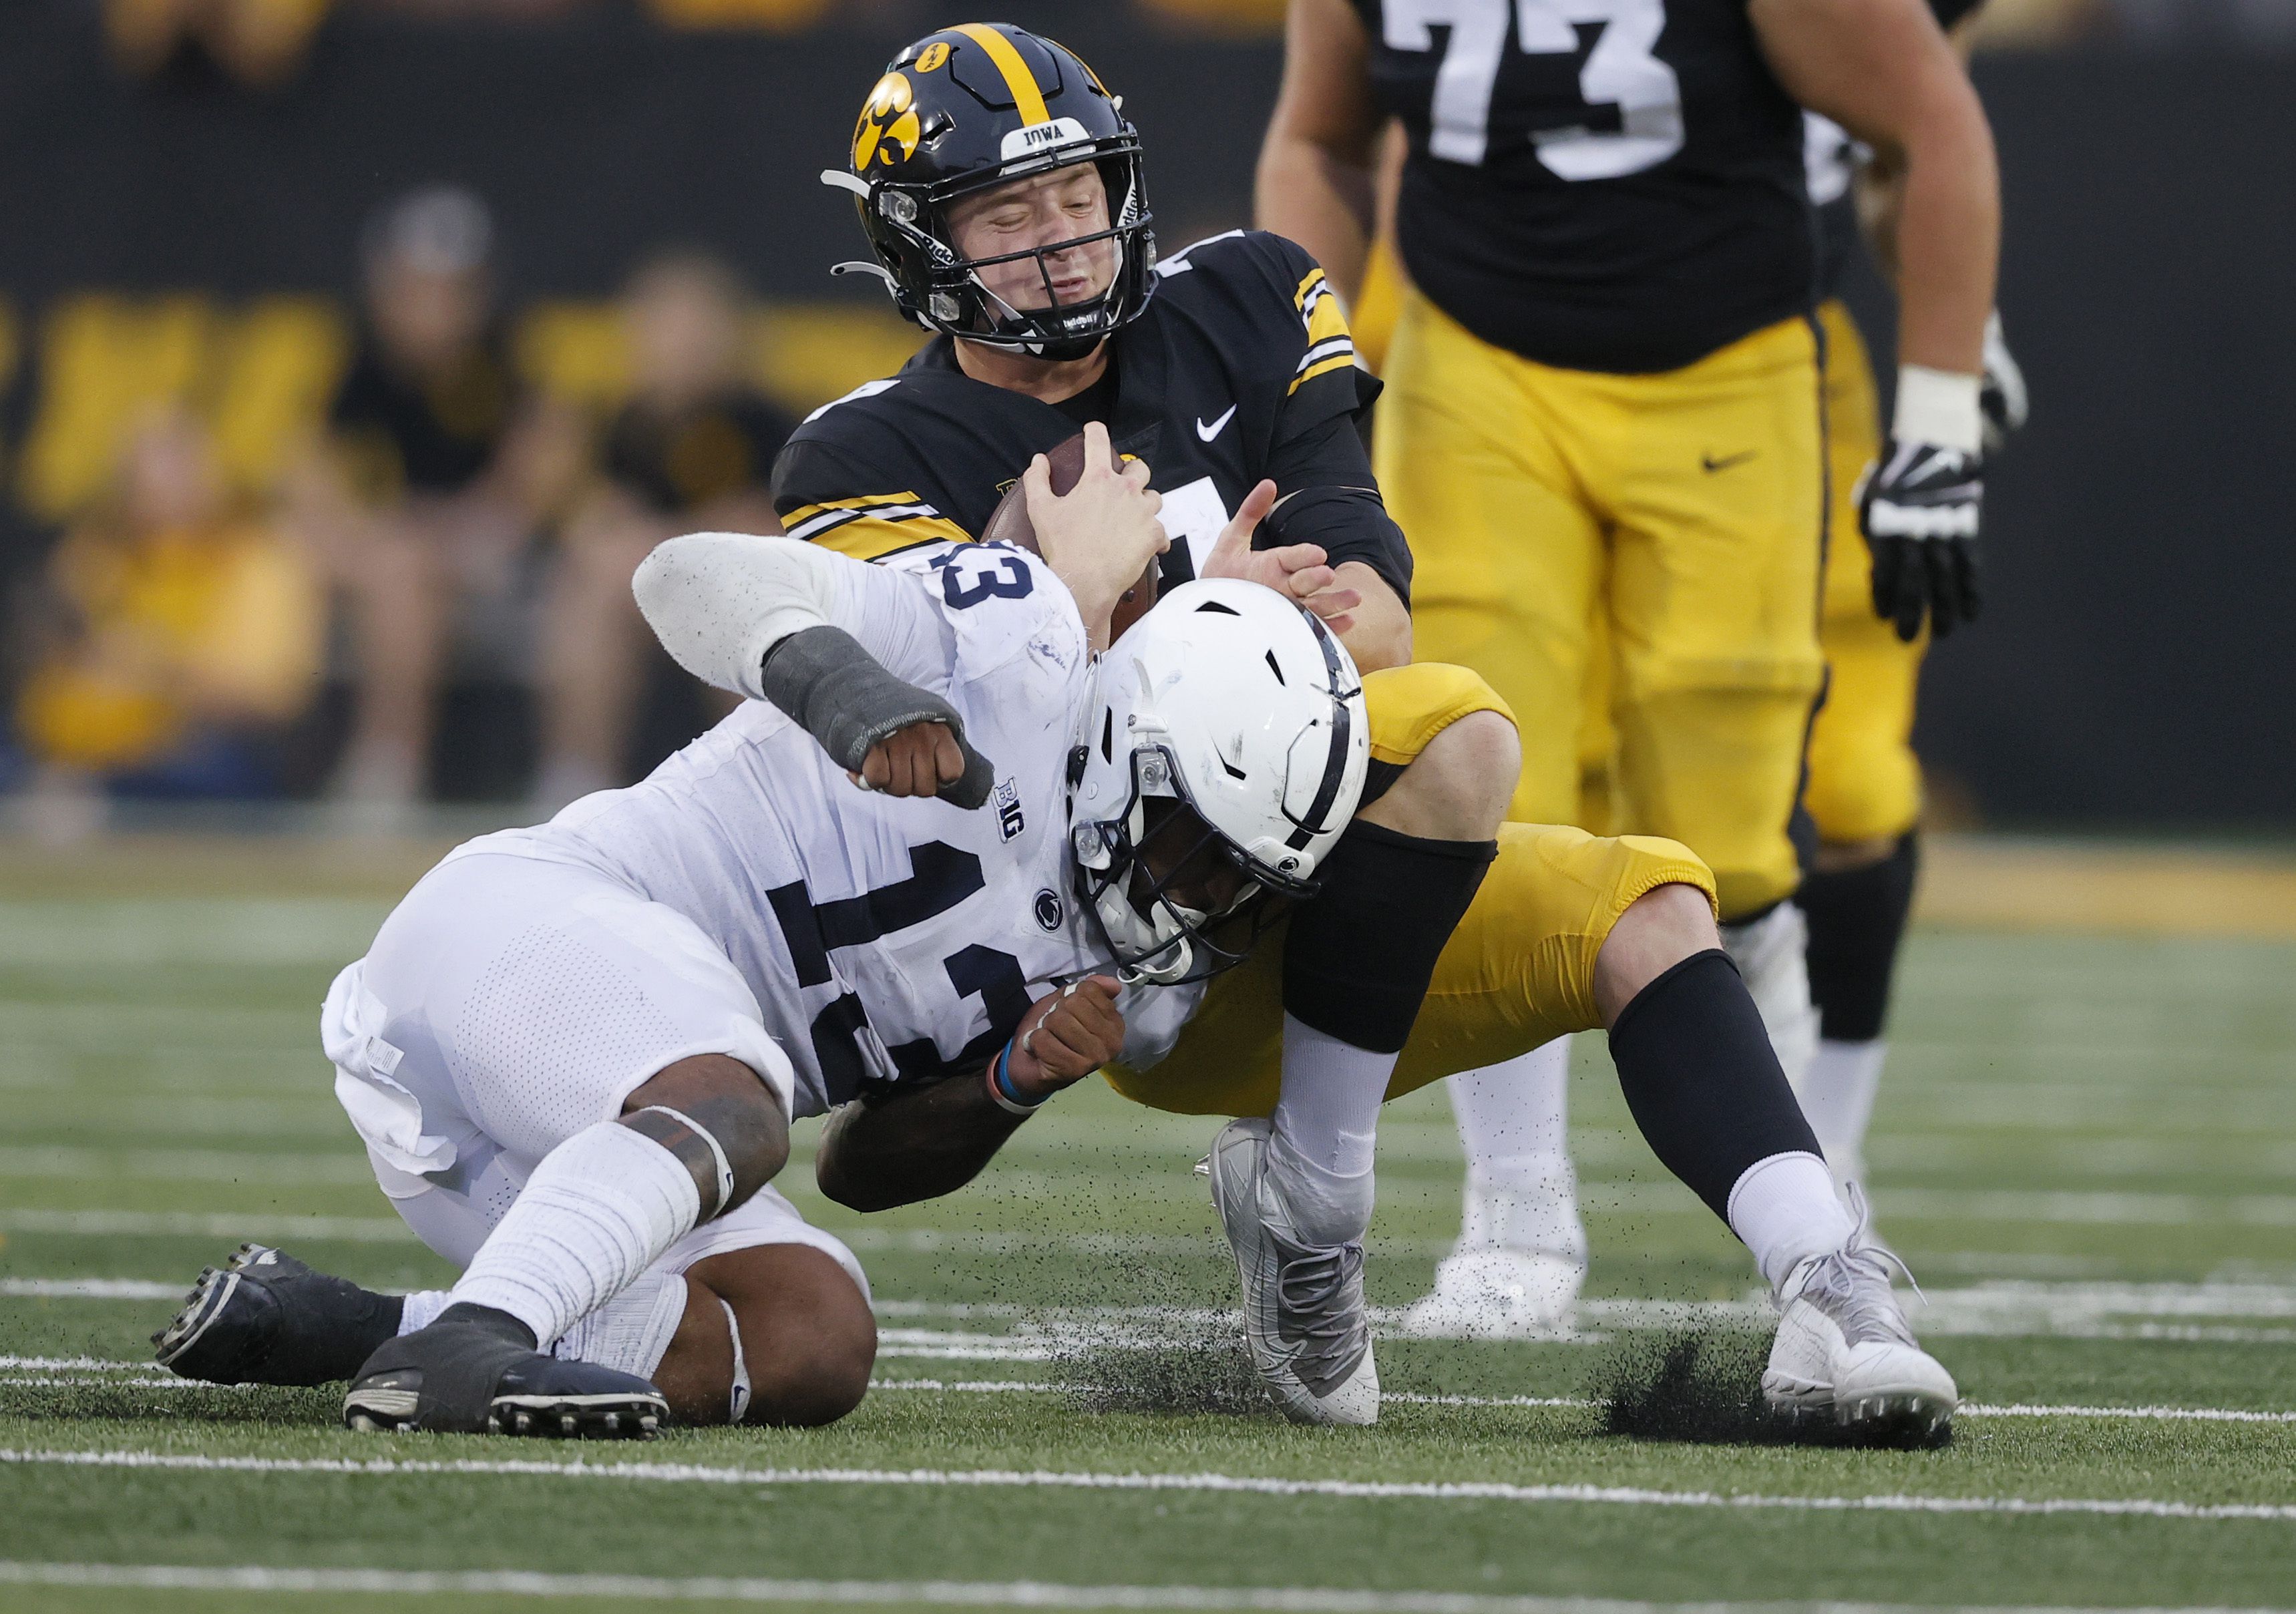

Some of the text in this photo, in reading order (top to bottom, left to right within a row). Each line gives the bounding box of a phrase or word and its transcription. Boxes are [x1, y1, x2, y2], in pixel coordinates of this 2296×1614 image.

[1023, 125, 1065, 146] IOWA
[1381, 0, 1686, 181] 73
[928, 540, 1034, 610] 13
[765, 839, 1038, 1108] 13
